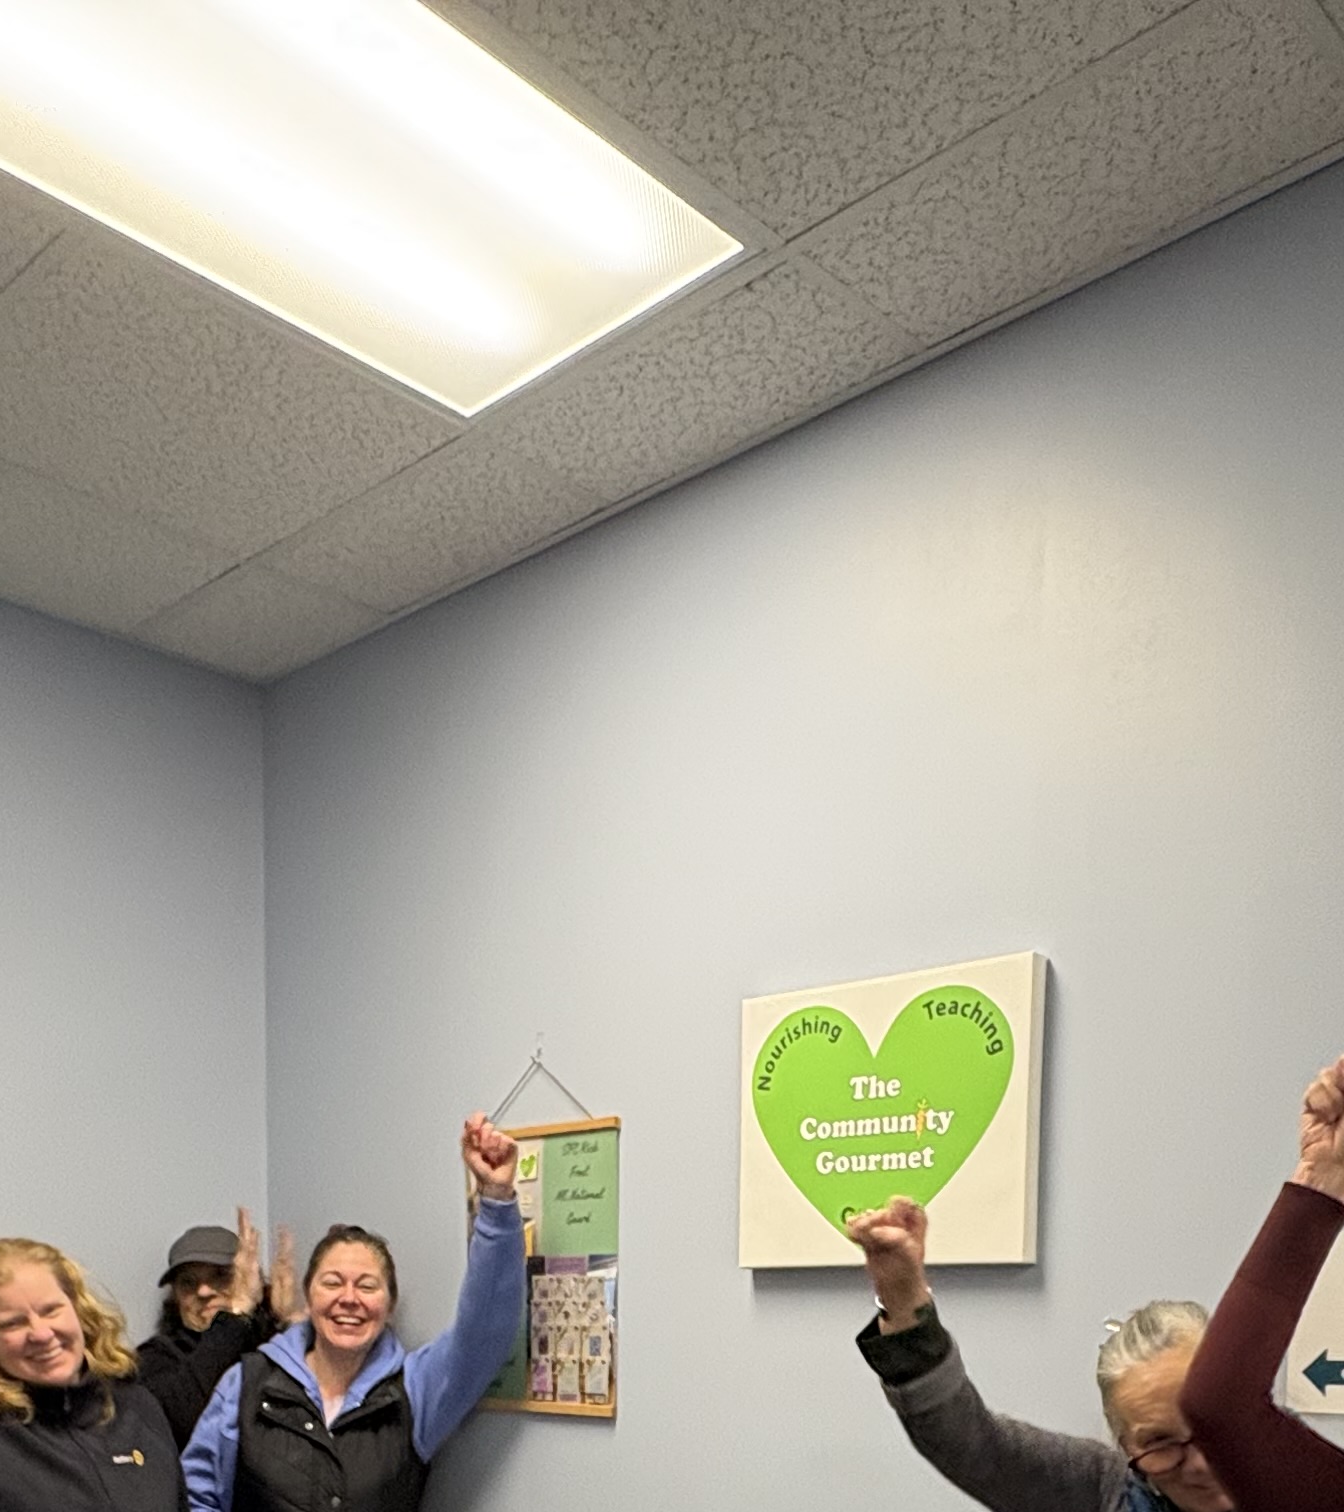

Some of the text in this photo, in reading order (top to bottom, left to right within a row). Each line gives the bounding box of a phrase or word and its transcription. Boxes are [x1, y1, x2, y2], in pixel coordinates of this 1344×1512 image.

[757, 999, 1004, 1091] Nourishing Teaching
[849, 1075, 902, 1100] The
[799, 1100, 955, 1142] Community
[815, 1146, 935, 1175] Gourmet
